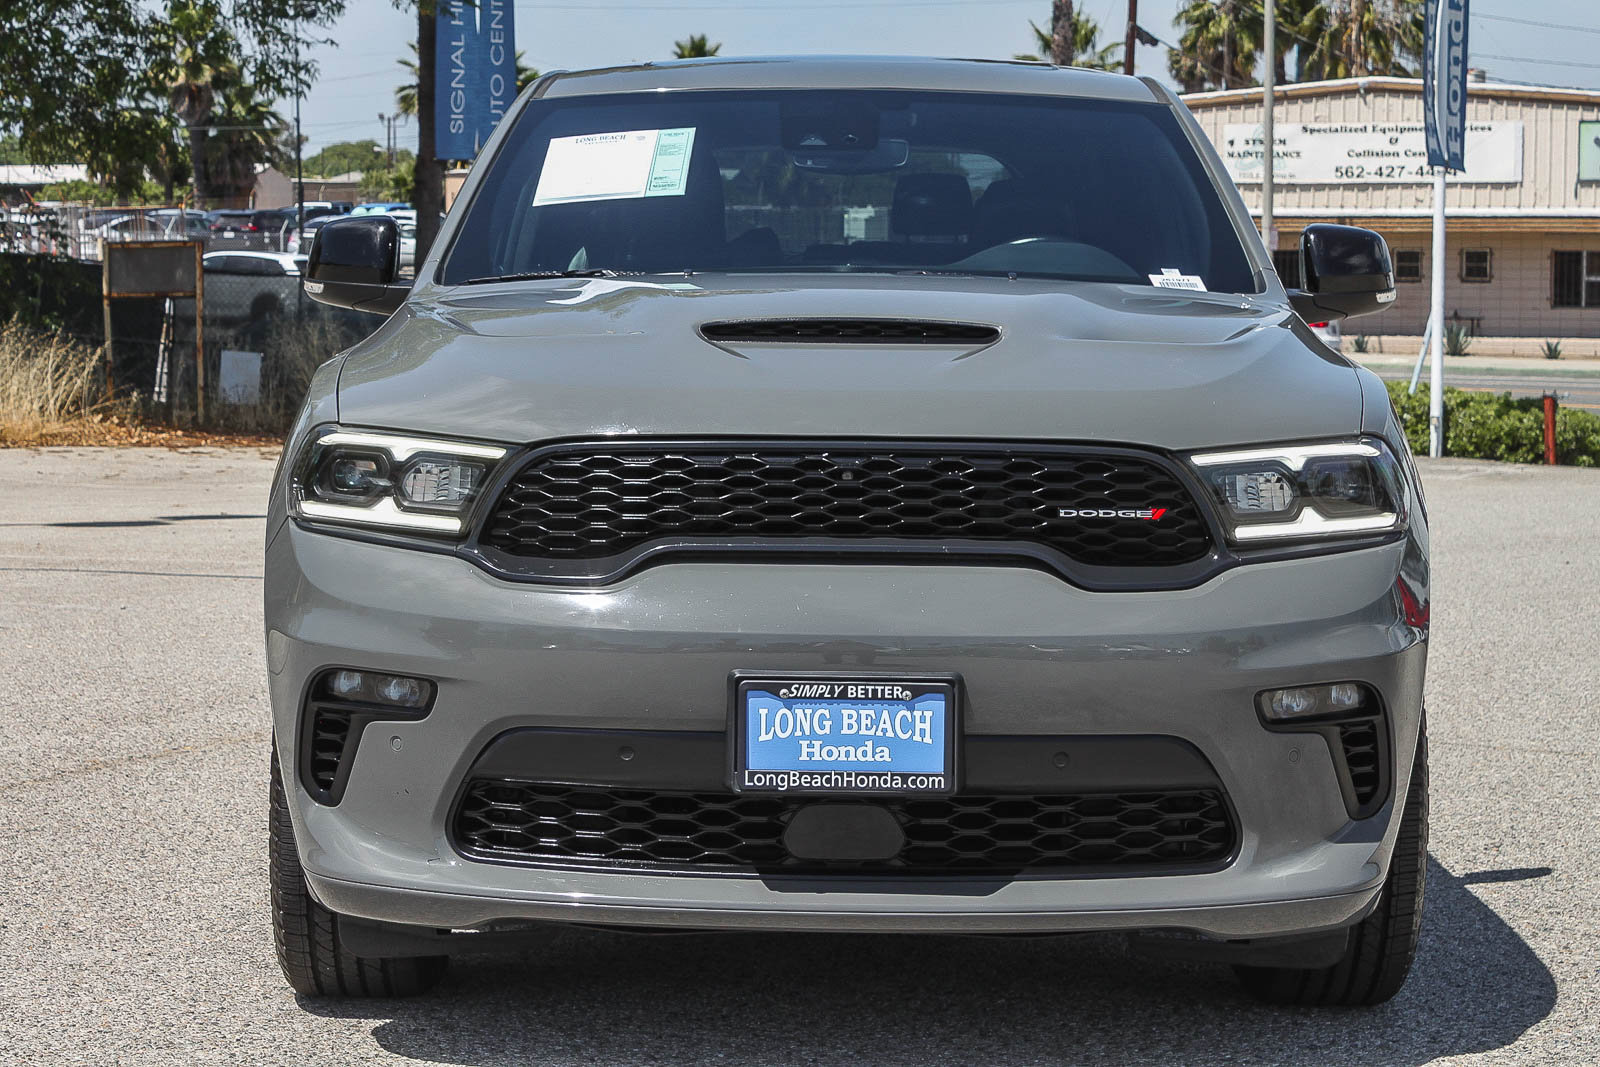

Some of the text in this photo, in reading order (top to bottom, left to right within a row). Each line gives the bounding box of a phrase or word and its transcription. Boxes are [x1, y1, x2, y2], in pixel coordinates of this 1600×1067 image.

[450, 34, 465, 134] SIGNAL
[1447, 0, 1464, 159] Hond
[490, 74, 505, 129] UTO
[1302, 125, 1367, 135] Specialized
[1372, 125, 1426, 135] Equipme
[1347, 149, 1426, 158] Collision Cen
[1335, 165, 1457, 178] 562-427-444
[1059, 508, 1153, 518] DODGE
[788, 684, 903, 699] SIMPLY BETTER
[758, 708, 933, 744] LONG BEACH
[798, 740, 892, 762] Honda
[744, 770, 945, 790] LongBeachHonda.com
